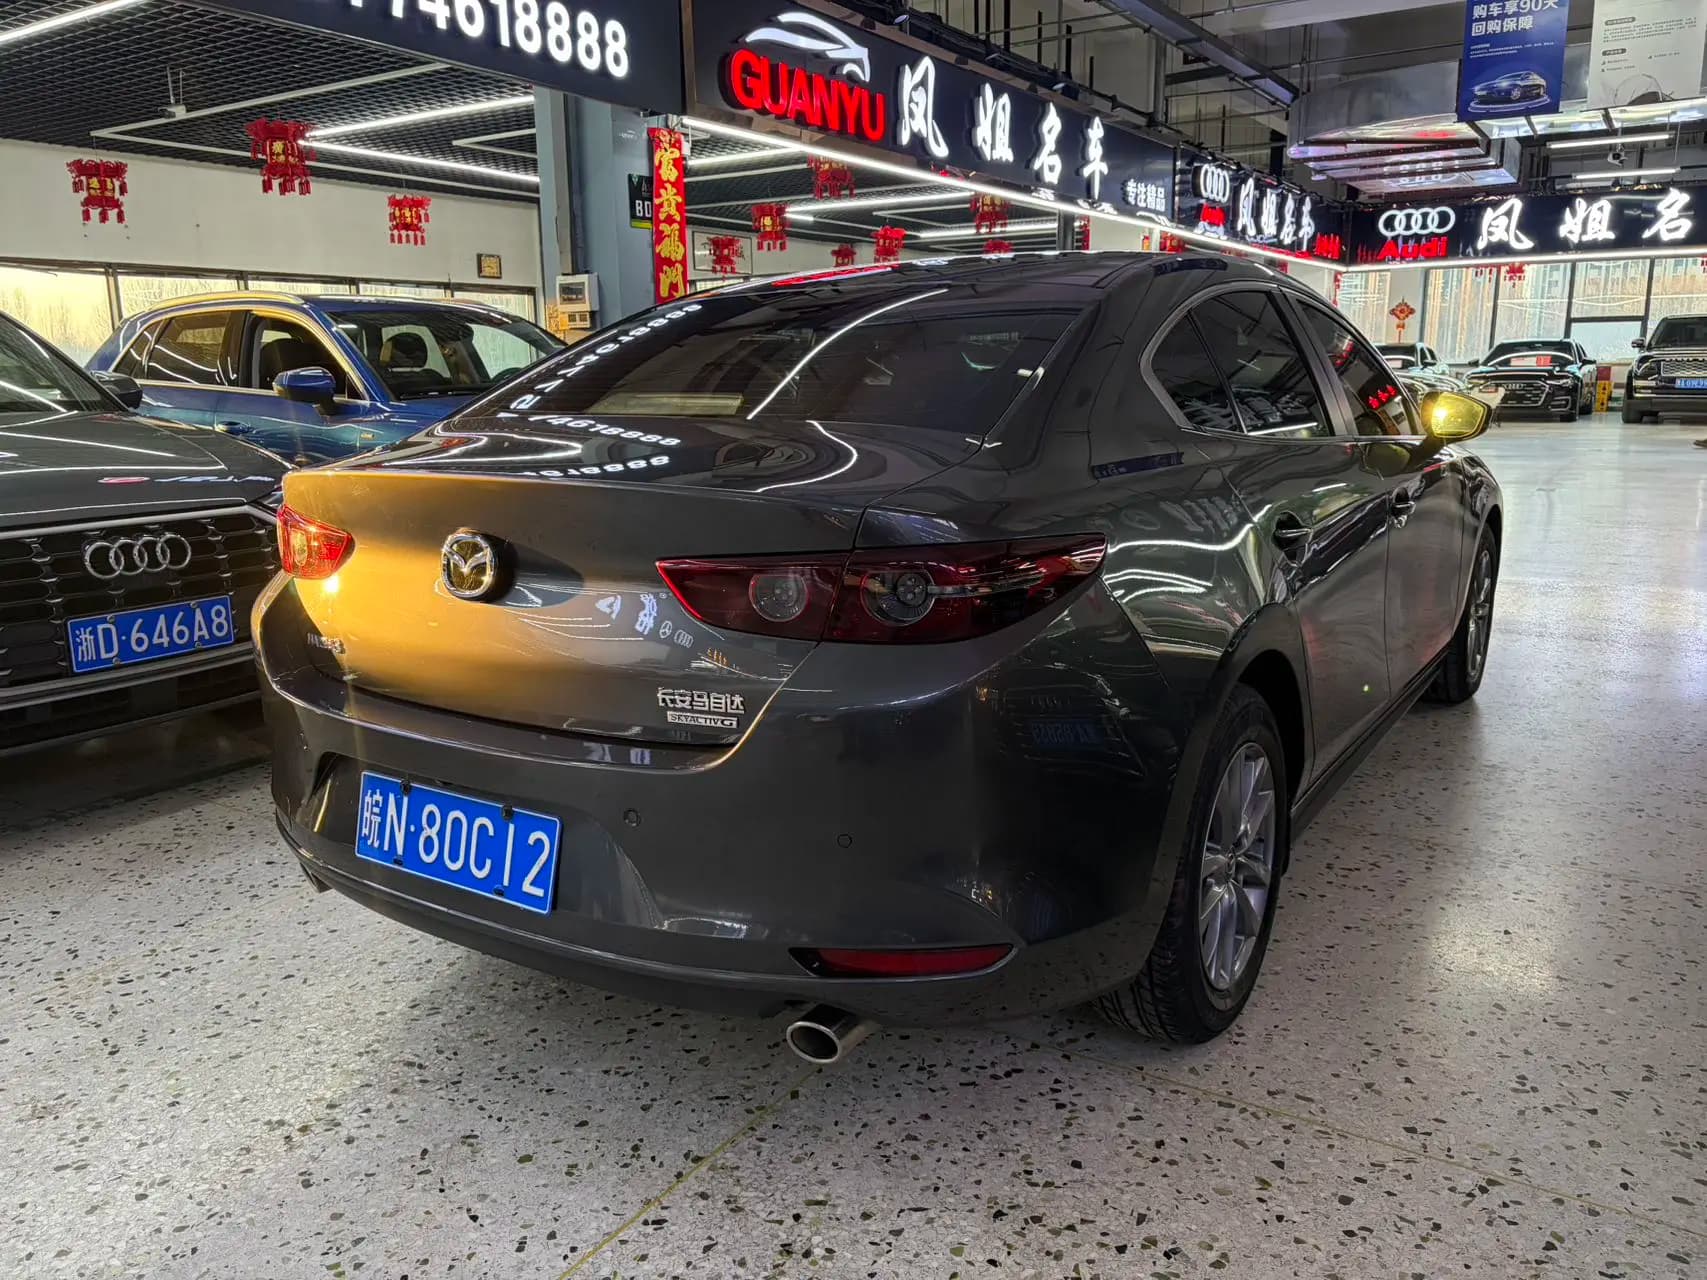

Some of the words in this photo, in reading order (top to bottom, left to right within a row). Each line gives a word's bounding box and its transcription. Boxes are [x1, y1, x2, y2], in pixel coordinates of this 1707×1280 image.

[1471, 15, 1534, 37] 回购保障
[729, 48, 885, 142] GUANYU
[897, 55, 1109, 200] 凤姐名车
[1376, 236, 1449, 260] Audi
[657, 687, 745, 714] 长安马自达
